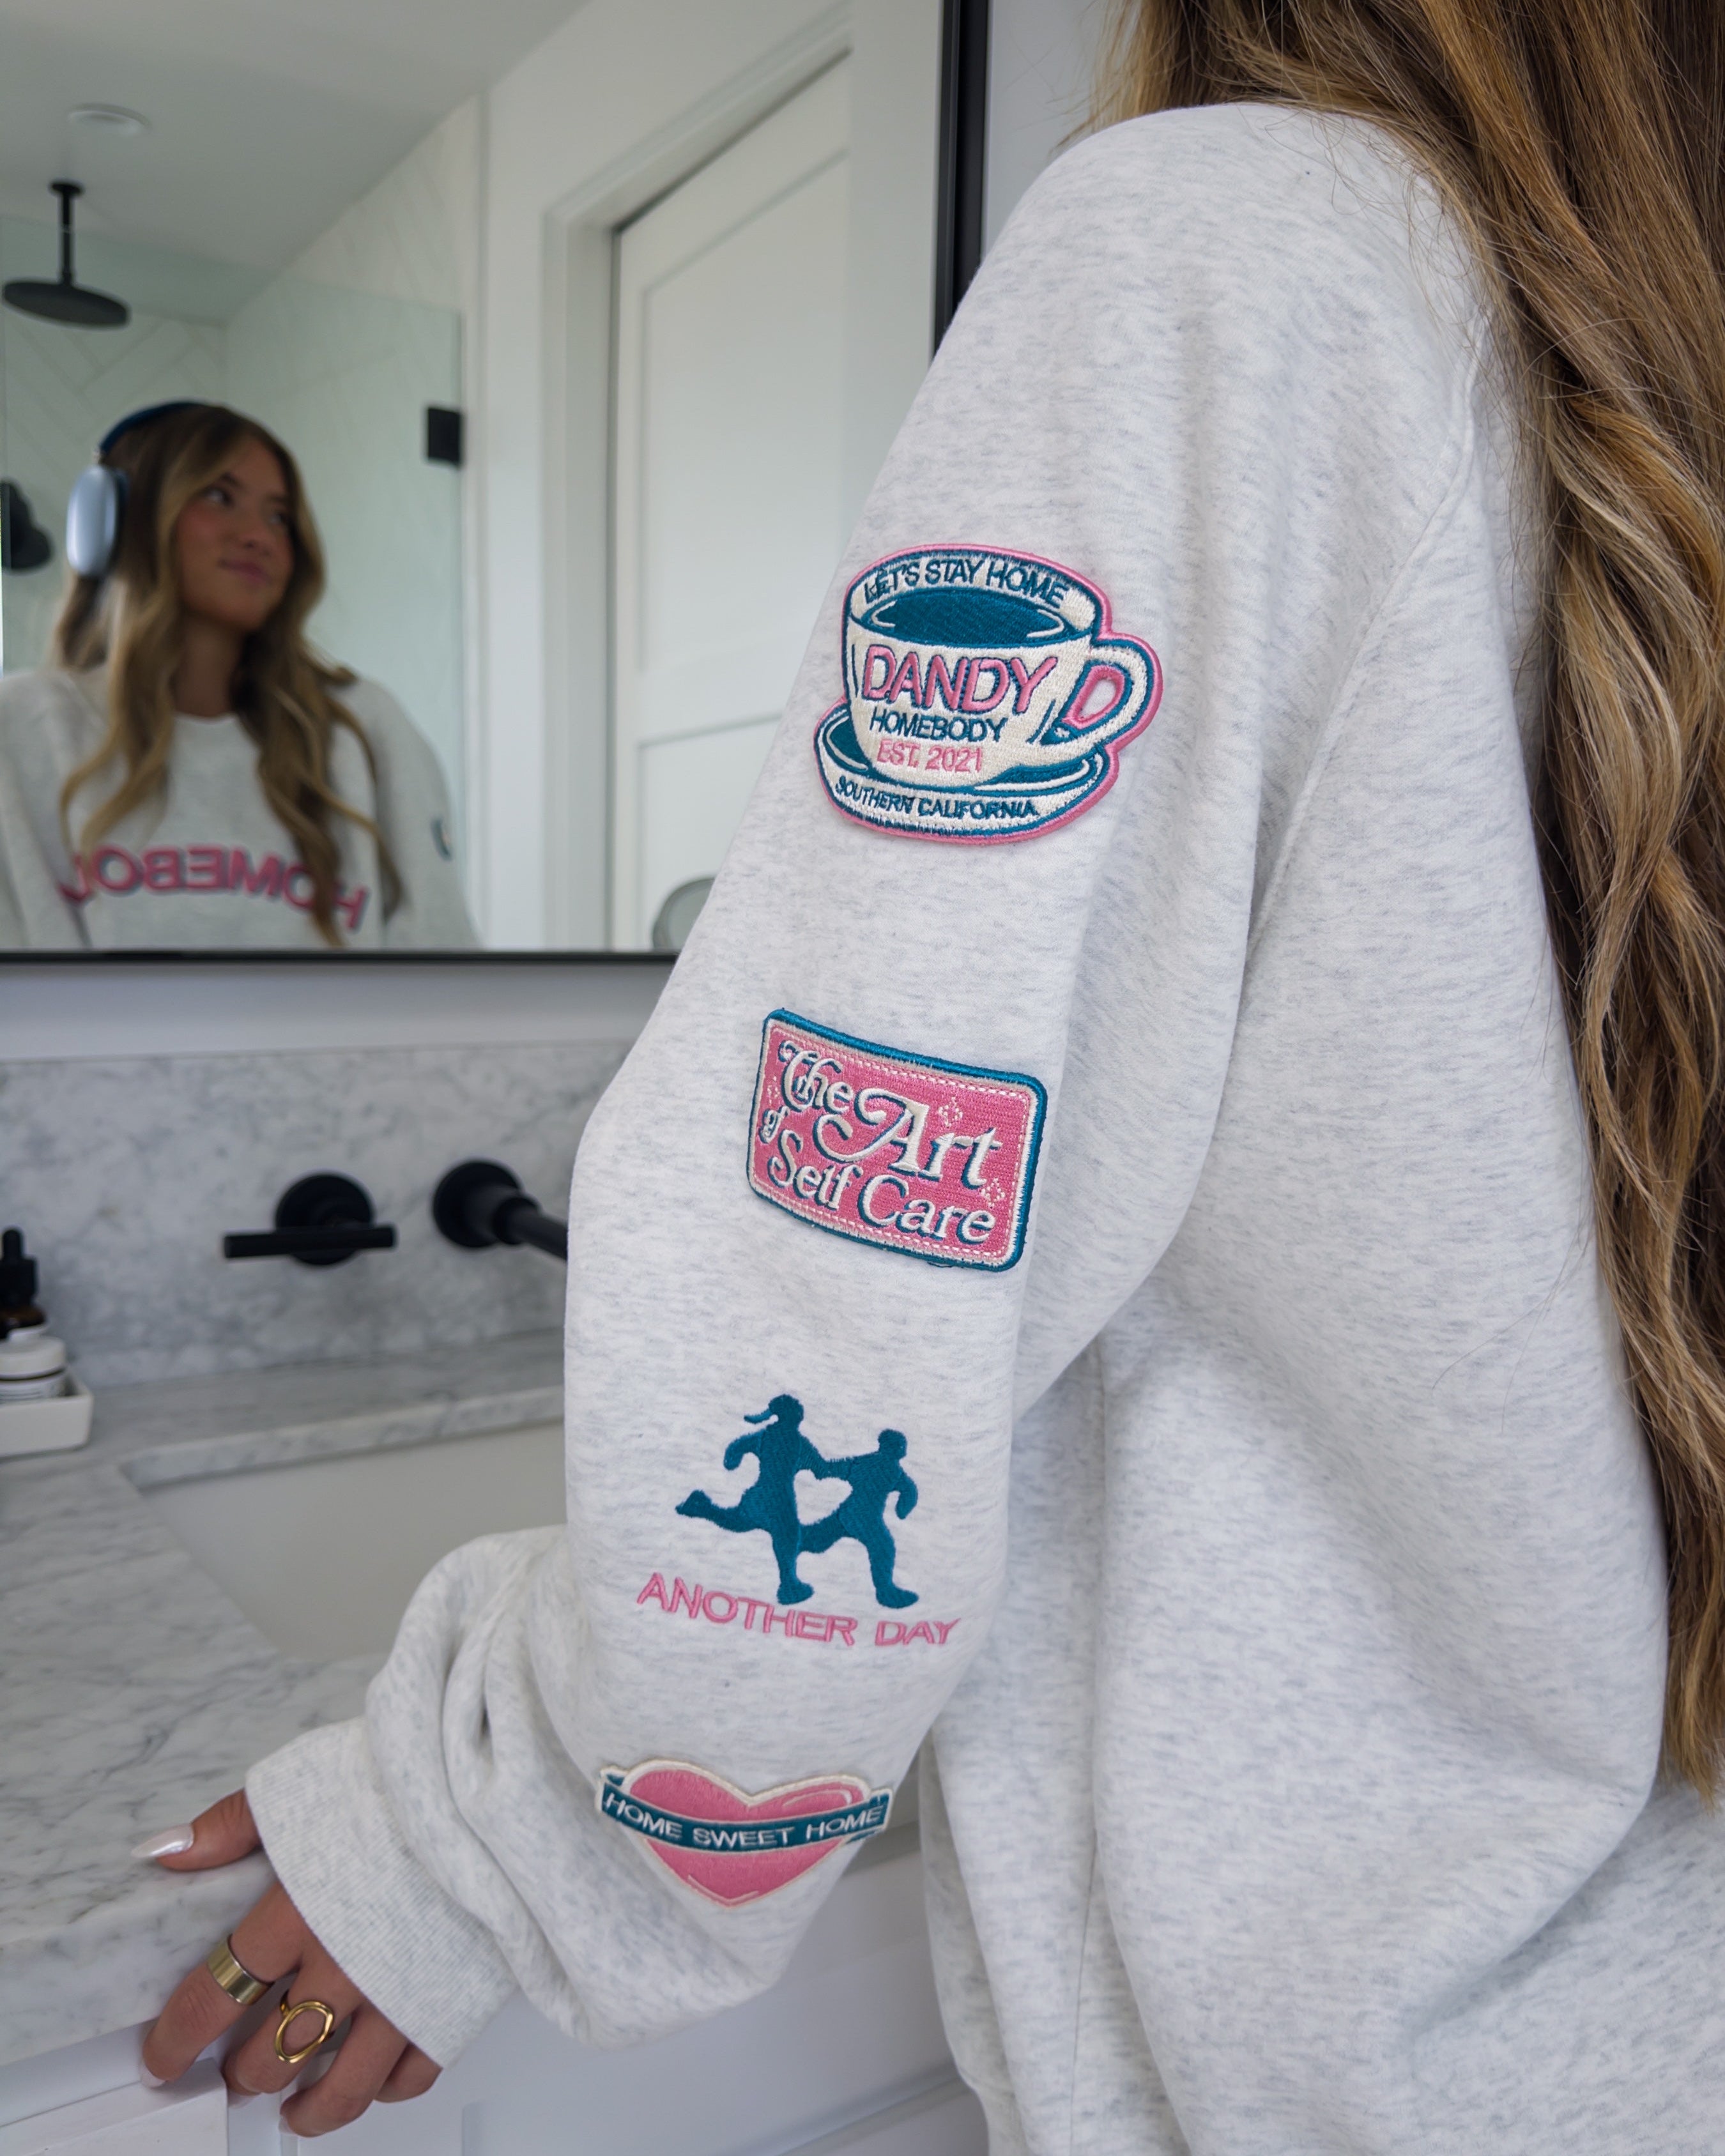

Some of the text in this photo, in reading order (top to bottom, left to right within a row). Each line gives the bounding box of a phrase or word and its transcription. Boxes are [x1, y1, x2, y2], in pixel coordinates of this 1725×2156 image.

[865, 559, 1068, 609] LET'S STAY HOME
[863, 645, 1057, 713] DANDY
[870, 708, 1006, 742] HOMEBODY
[924, 747, 983, 772] 2021
[836, 776, 1039, 820] SOUTHERN CALIFORNIA
[778, 1040, 1004, 1189] The Art
[768, 1129, 996, 1243] Self Care
[636, 1571, 961, 1646] ANOTHER DAY
[606, 1792, 884, 1849] HOME SWEET HOME
